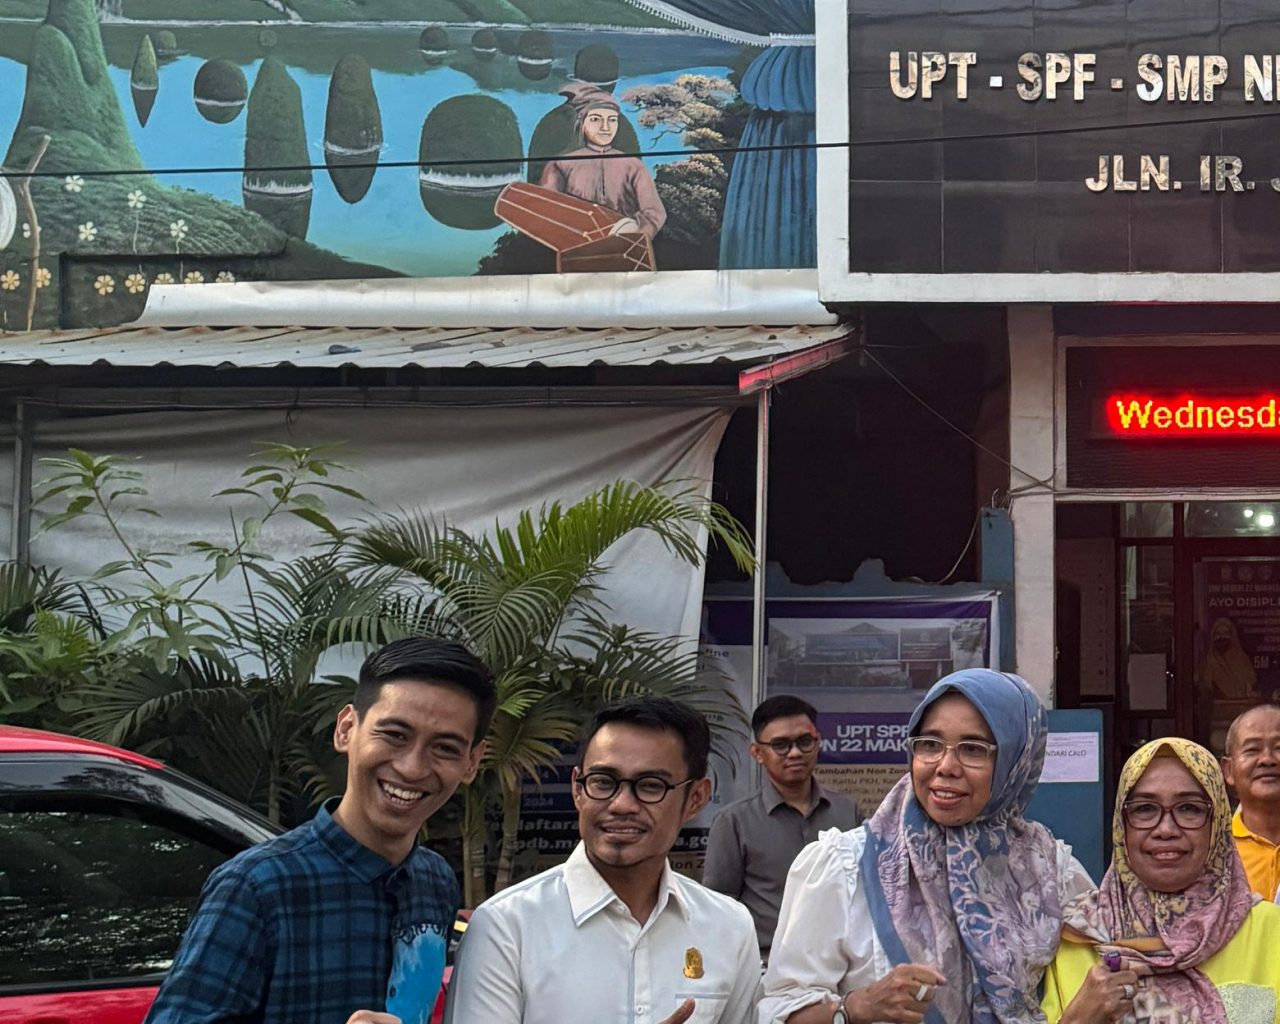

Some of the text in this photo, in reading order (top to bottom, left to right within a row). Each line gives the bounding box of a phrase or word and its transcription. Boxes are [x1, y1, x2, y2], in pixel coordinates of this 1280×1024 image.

[889, 51, 977, 99] UPT
[1016, 52, 1096, 100] SPF
[1136, 53, 1228, 101] SMP
[1085, 155, 1182, 192] JLN.
[1200, 155, 1255, 191] IR.
[837, 725, 875, 738] UPT
[840, 739, 862, 752] 22
[866, 739, 908, 752] MAK
